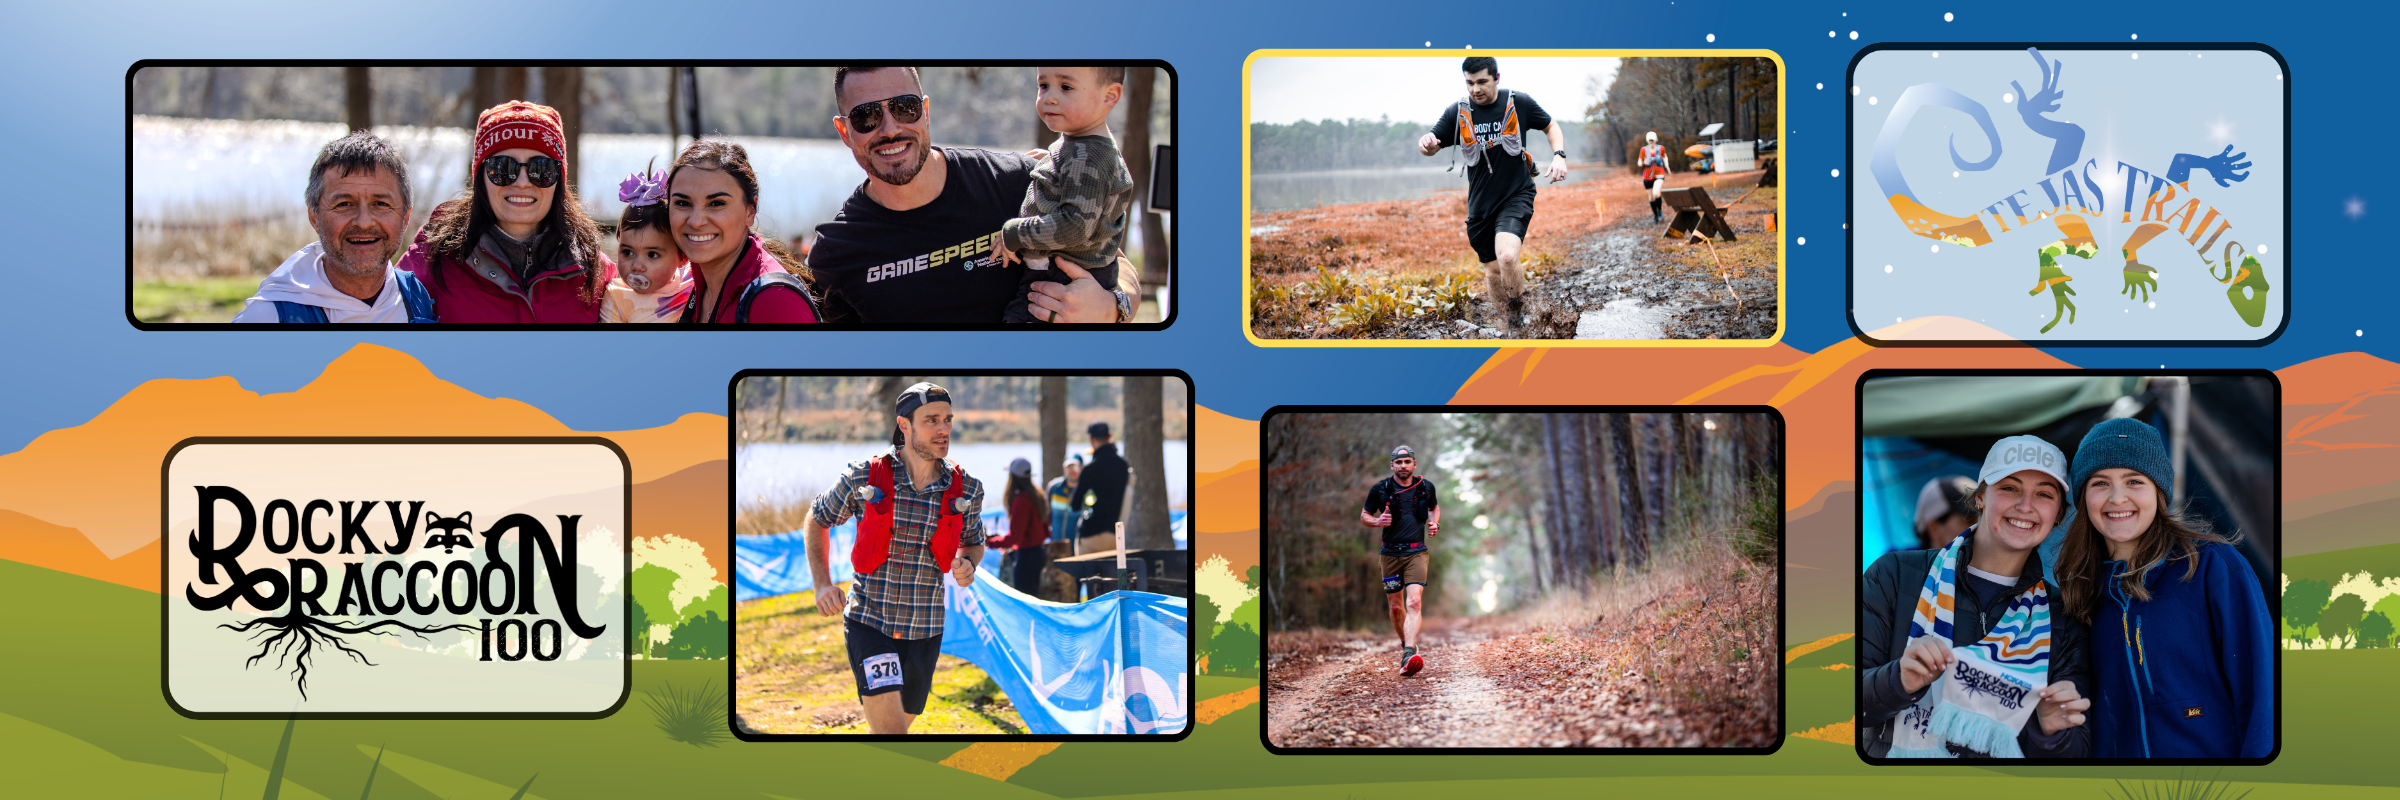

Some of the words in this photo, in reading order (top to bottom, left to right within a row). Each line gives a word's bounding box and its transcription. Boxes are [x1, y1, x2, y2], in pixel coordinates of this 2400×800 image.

[484, 128, 539, 151] sitour
[1474, 123, 1491, 133] BODY
[2003, 443, 2055, 469] ciele
[871, 661, 899, 679] 378
[1954, 660, 2001, 685] ROCKY
[1971, 677, 2030, 708] RACCOON
[1999, 698, 2017, 711] 100
